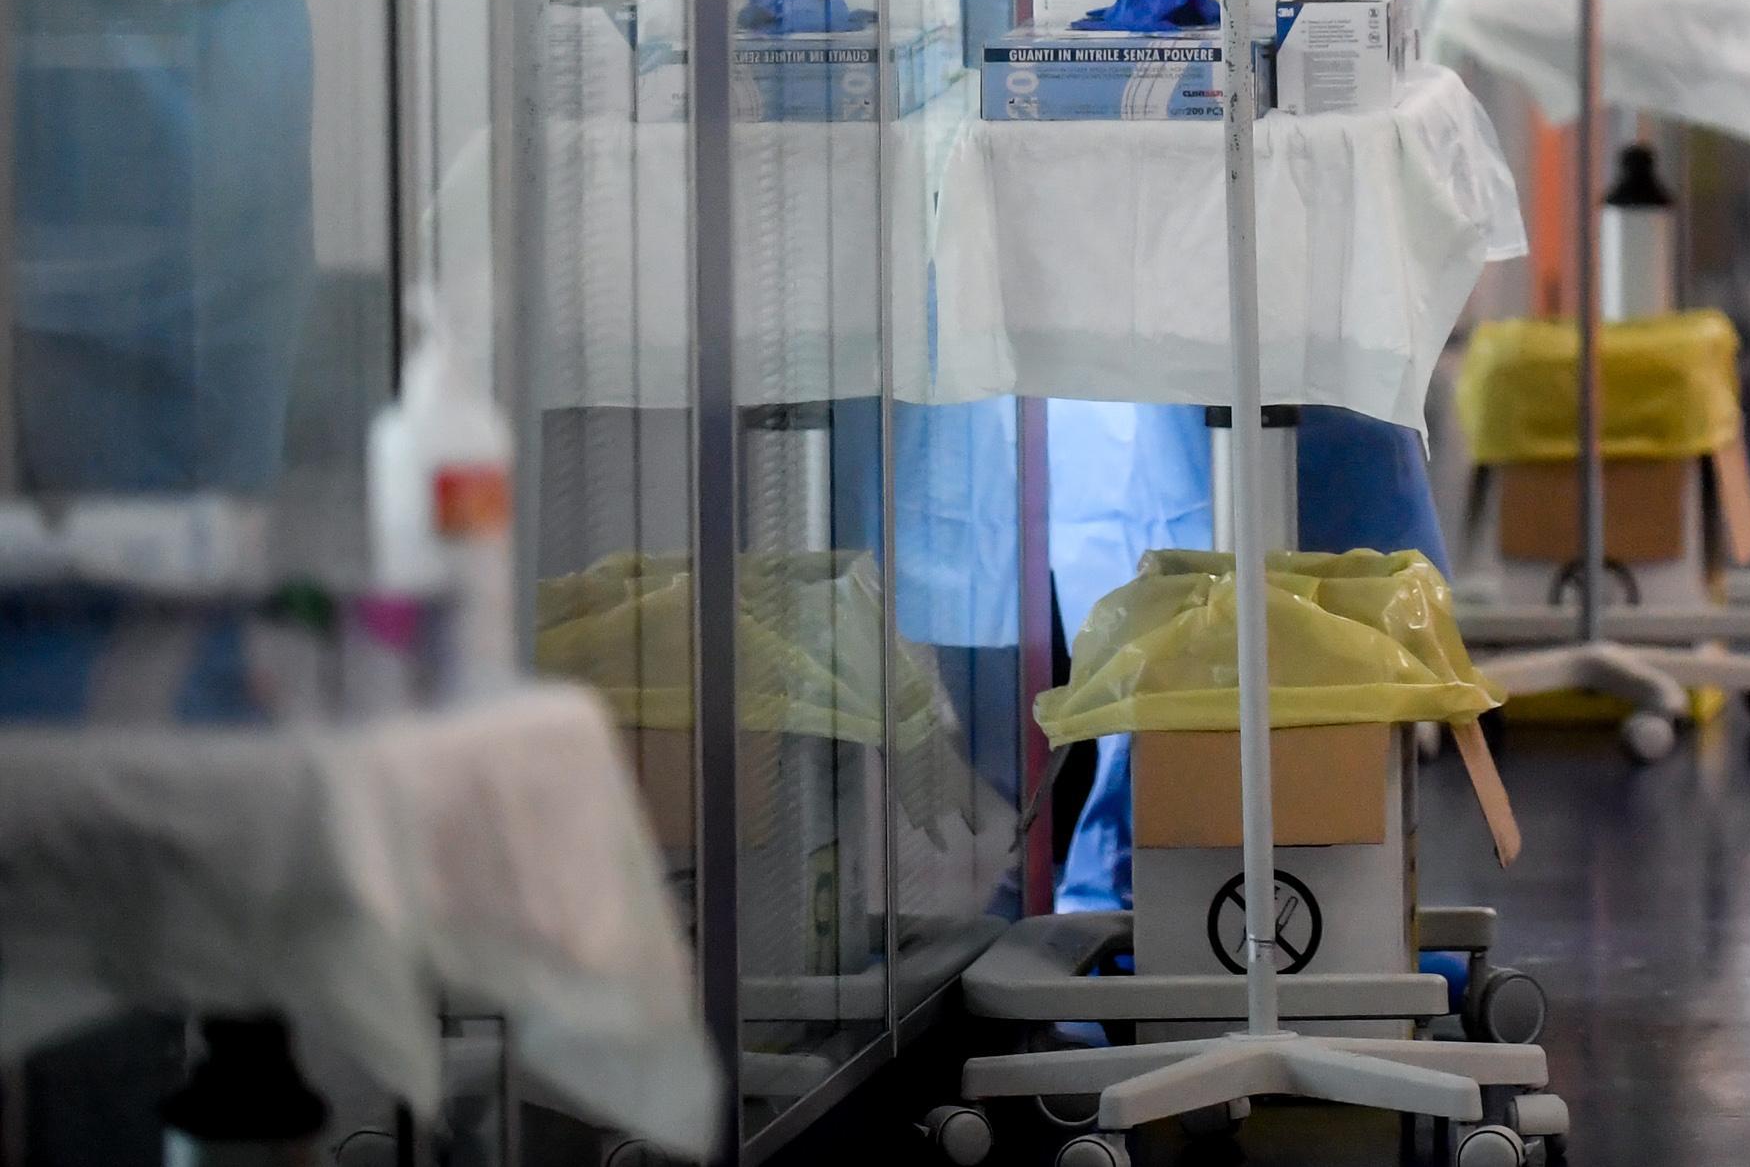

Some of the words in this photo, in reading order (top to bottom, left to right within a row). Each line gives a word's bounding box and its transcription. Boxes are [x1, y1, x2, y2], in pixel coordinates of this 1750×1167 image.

[1009, 49, 1054, 61] GUANTI
[1059, 49, 1071, 61] IN
[1076, 49, 1119, 61] NITRILE
[1124, 49, 1160, 60] SENZA
[1164, 49, 1214, 60] POLVERE
[1185, 107, 1204, 115] 200
